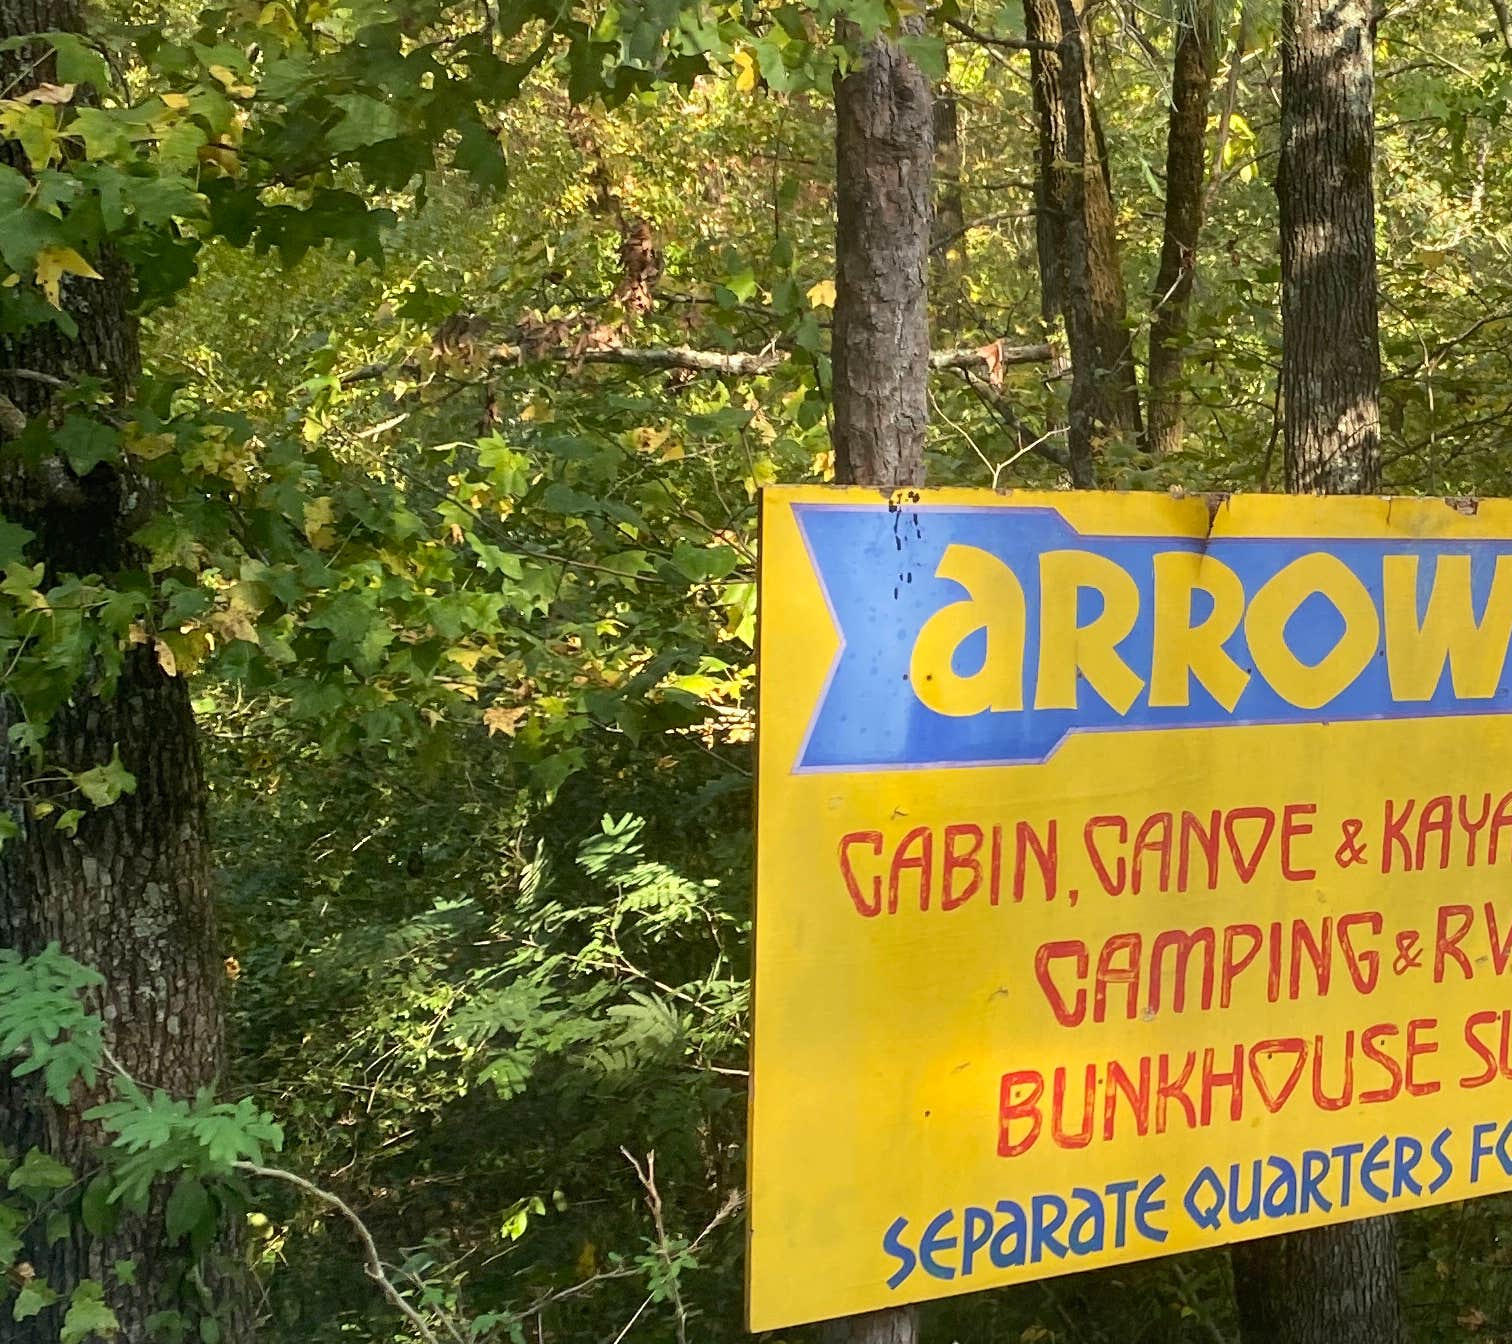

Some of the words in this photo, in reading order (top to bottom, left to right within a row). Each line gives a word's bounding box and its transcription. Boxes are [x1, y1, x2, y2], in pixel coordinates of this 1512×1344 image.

[838, 818, 1079, 918] CABIN,
[1084, 803, 1317, 897] CANOE
[1335, 818, 1367, 868] &
[1034, 911, 1383, 1028] CAMPING
[1392, 930, 1422, 975] &
[996, 1018, 1441, 1158] BUNKHOUSE
